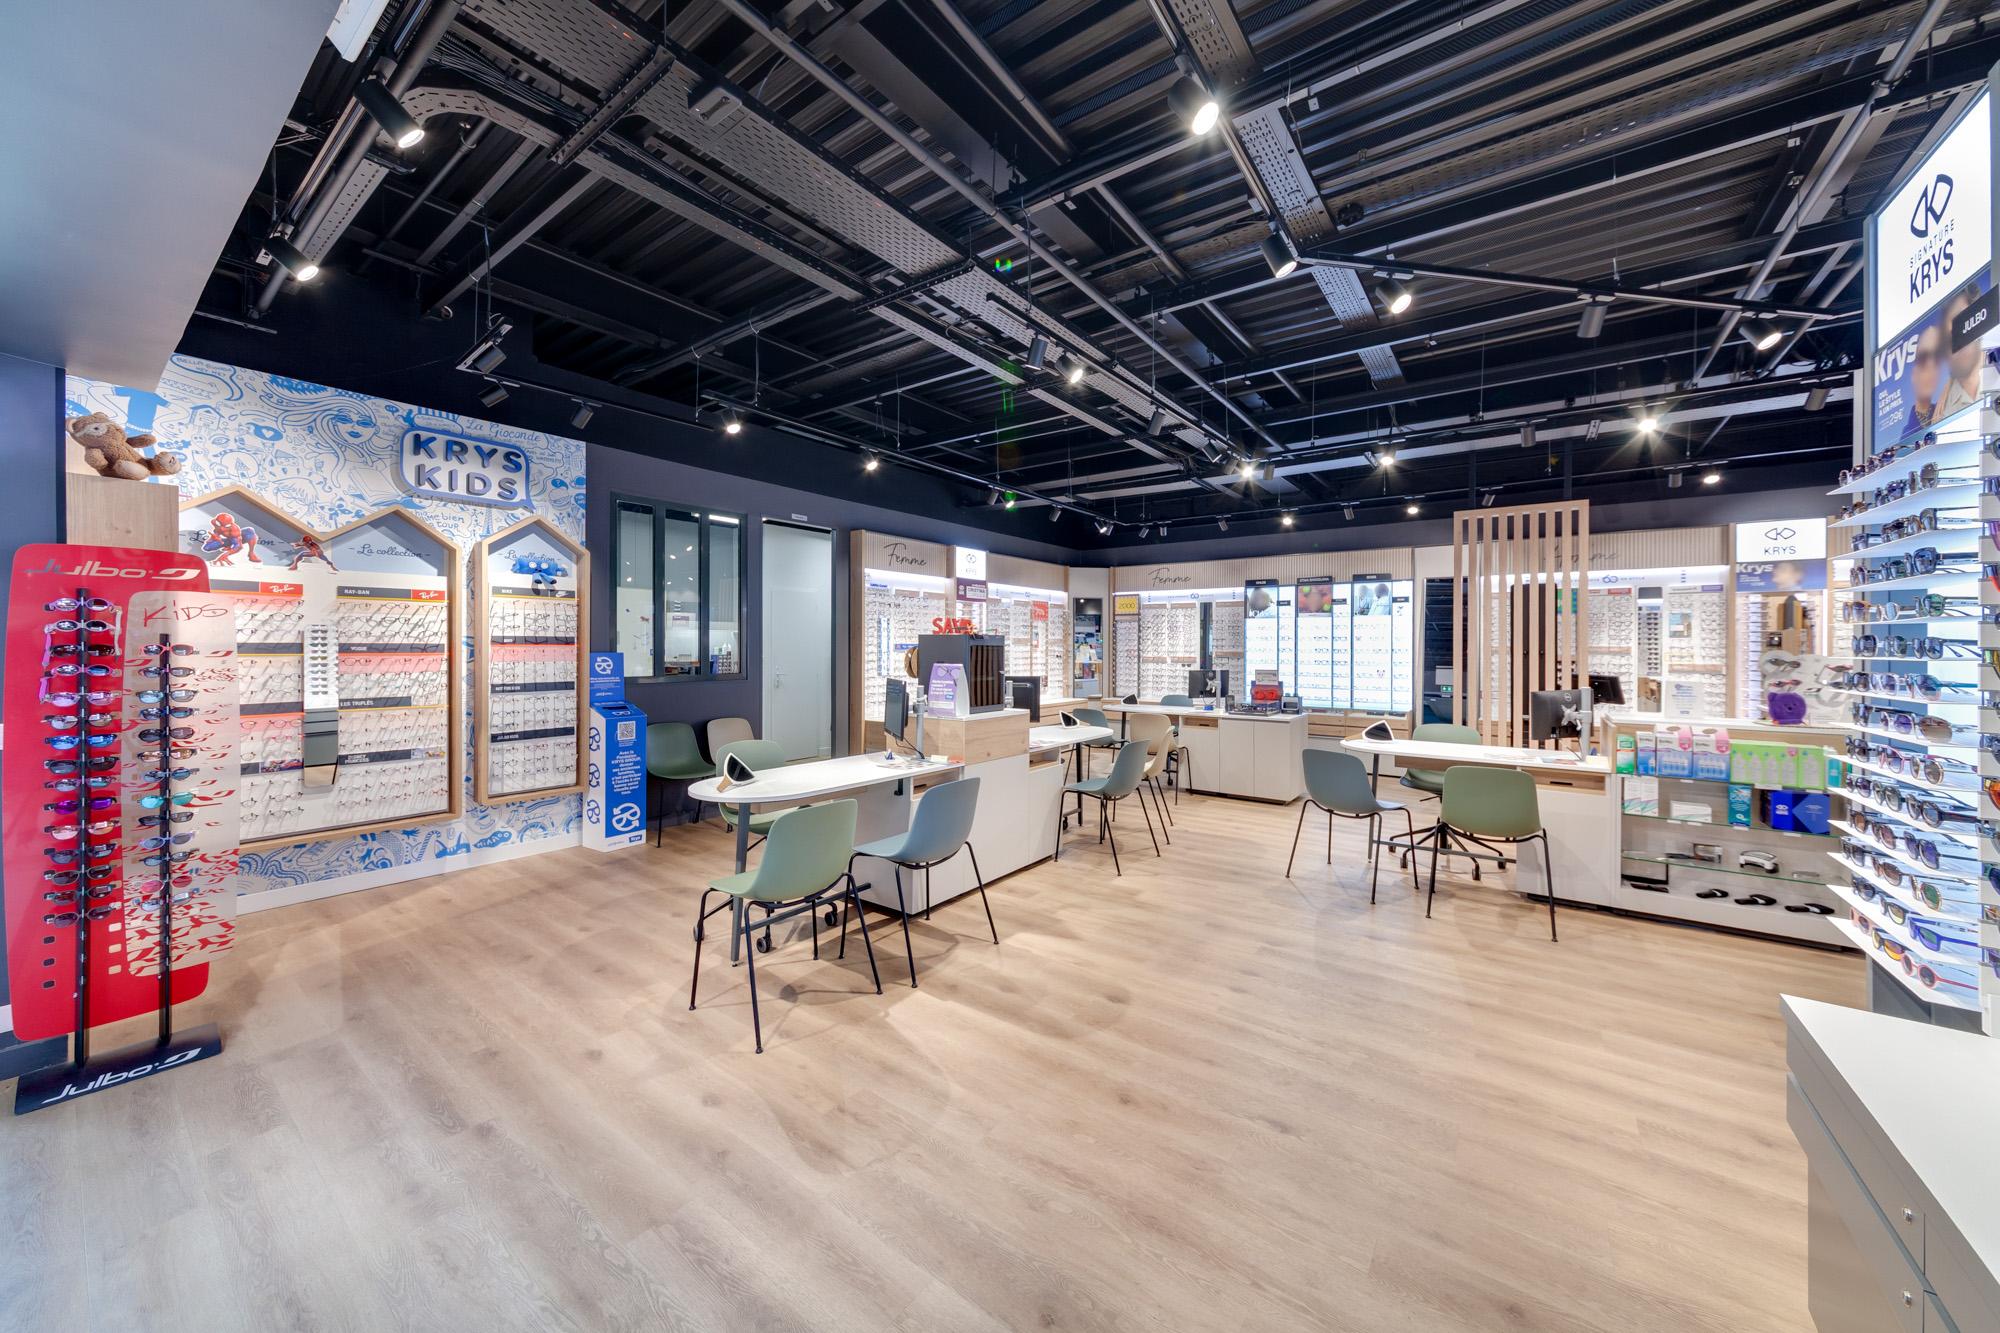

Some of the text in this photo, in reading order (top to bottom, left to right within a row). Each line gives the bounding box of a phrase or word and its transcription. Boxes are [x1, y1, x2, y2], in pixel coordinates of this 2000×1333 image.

[1910, 218, 1955, 269] SIGNATURE
[1910, 238, 1954, 304] KRYS
[1962, 308, 1987, 334] JULBO
[1874, 334, 1919, 388] Krys
[412, 433, 523, 473] KRYS
[414, 463, 518, 501] KIDS
[356, 543, 425, 559] La collection
[884, 542, 927, 568] Femme
[1764, 545, 1797, 556] KRYS
[1148, 567, 1192, 588] Femme
[1735, 563, 1774, 575] Krys
[41, 1064, 153, 1104] Julbo
